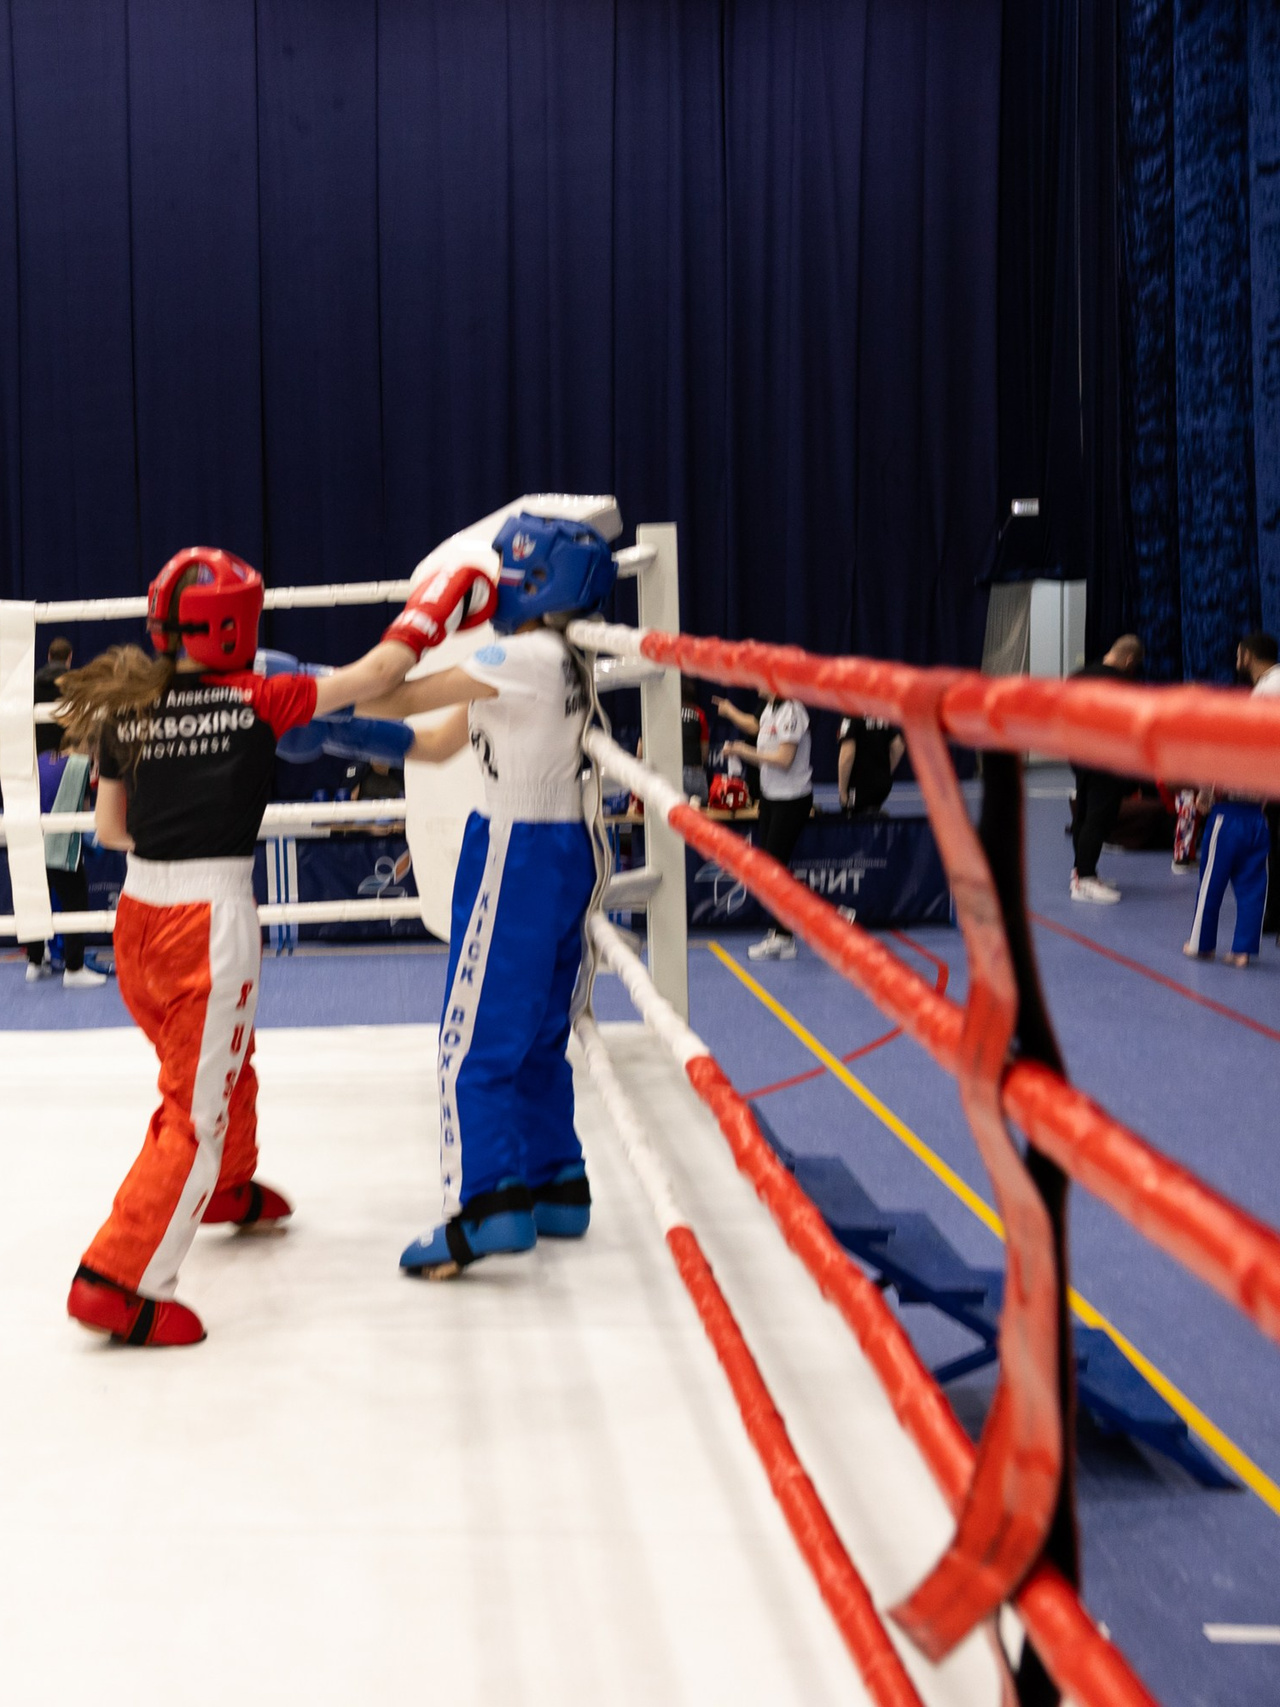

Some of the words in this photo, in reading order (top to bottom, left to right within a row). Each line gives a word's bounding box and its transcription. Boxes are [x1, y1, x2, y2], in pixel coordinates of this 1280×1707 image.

[117, 707, 255, 743] KICKBOXING
[793, 868, 866, 894] НИТ
[460, 891, 490, 987] KICK
